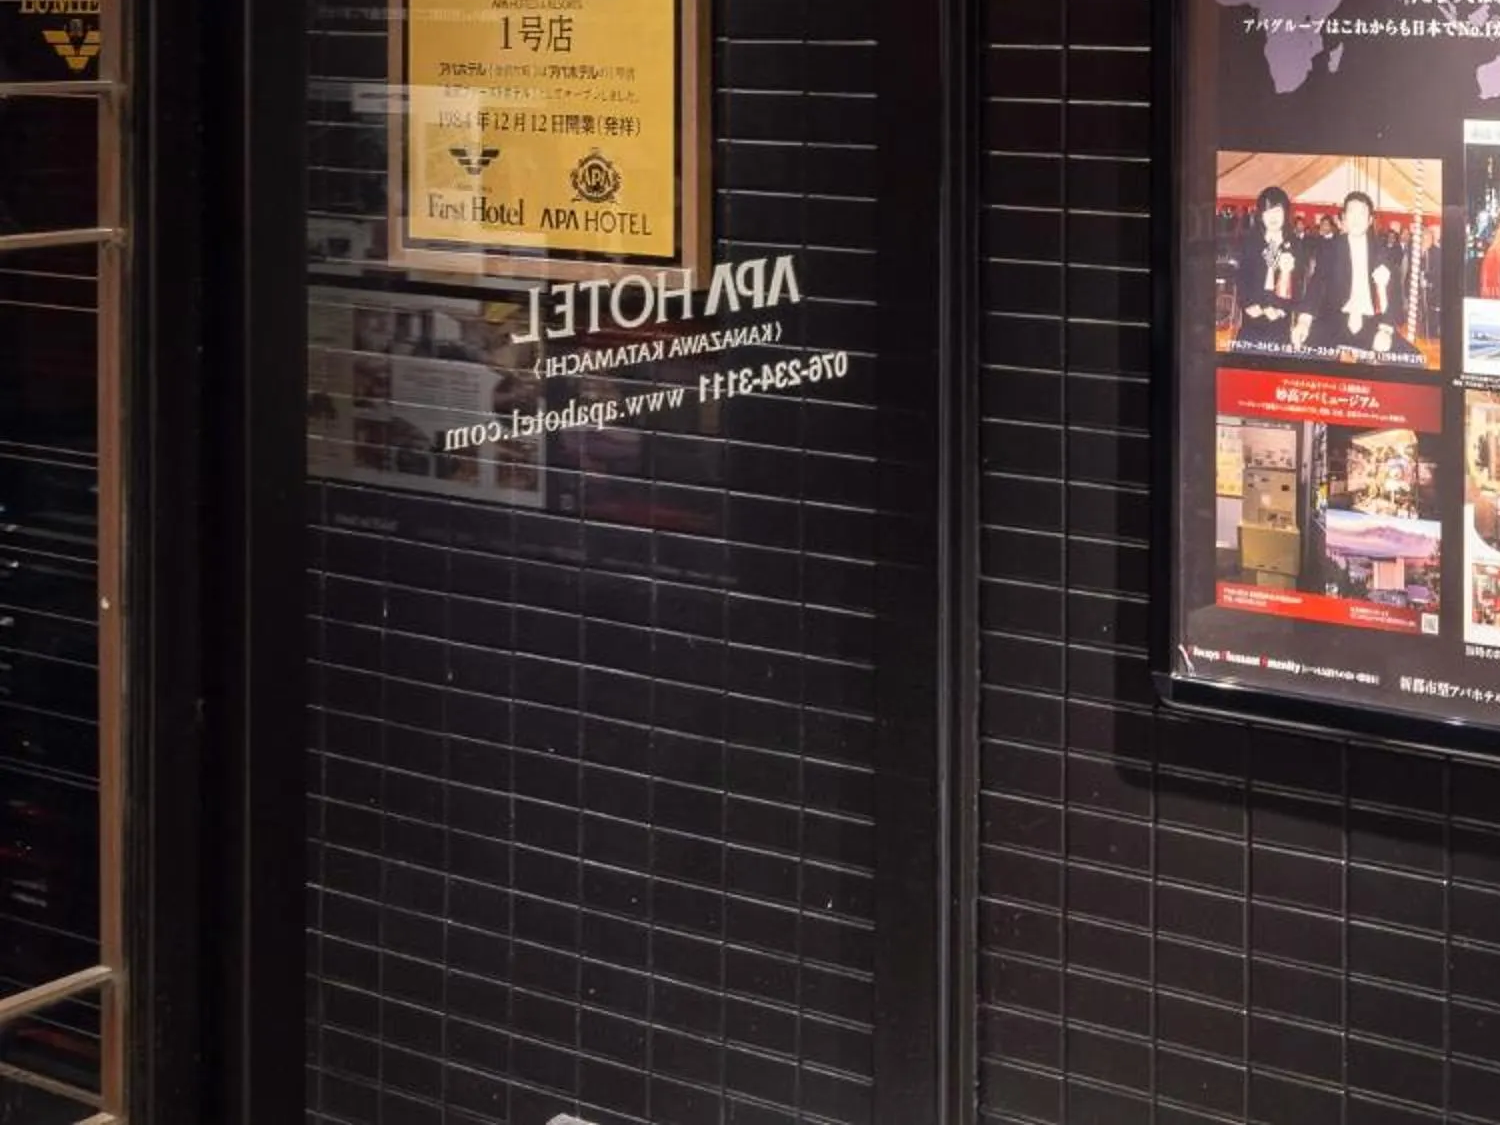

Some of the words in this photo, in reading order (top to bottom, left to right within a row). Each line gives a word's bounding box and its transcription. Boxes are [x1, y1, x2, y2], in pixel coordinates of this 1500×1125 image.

[501, 14, 573, 53] 1号店
[471, 195, 525, 227] Hotel
[539, 208, 580, 231] APA
[585, 210, 653, 236] HOTEL
